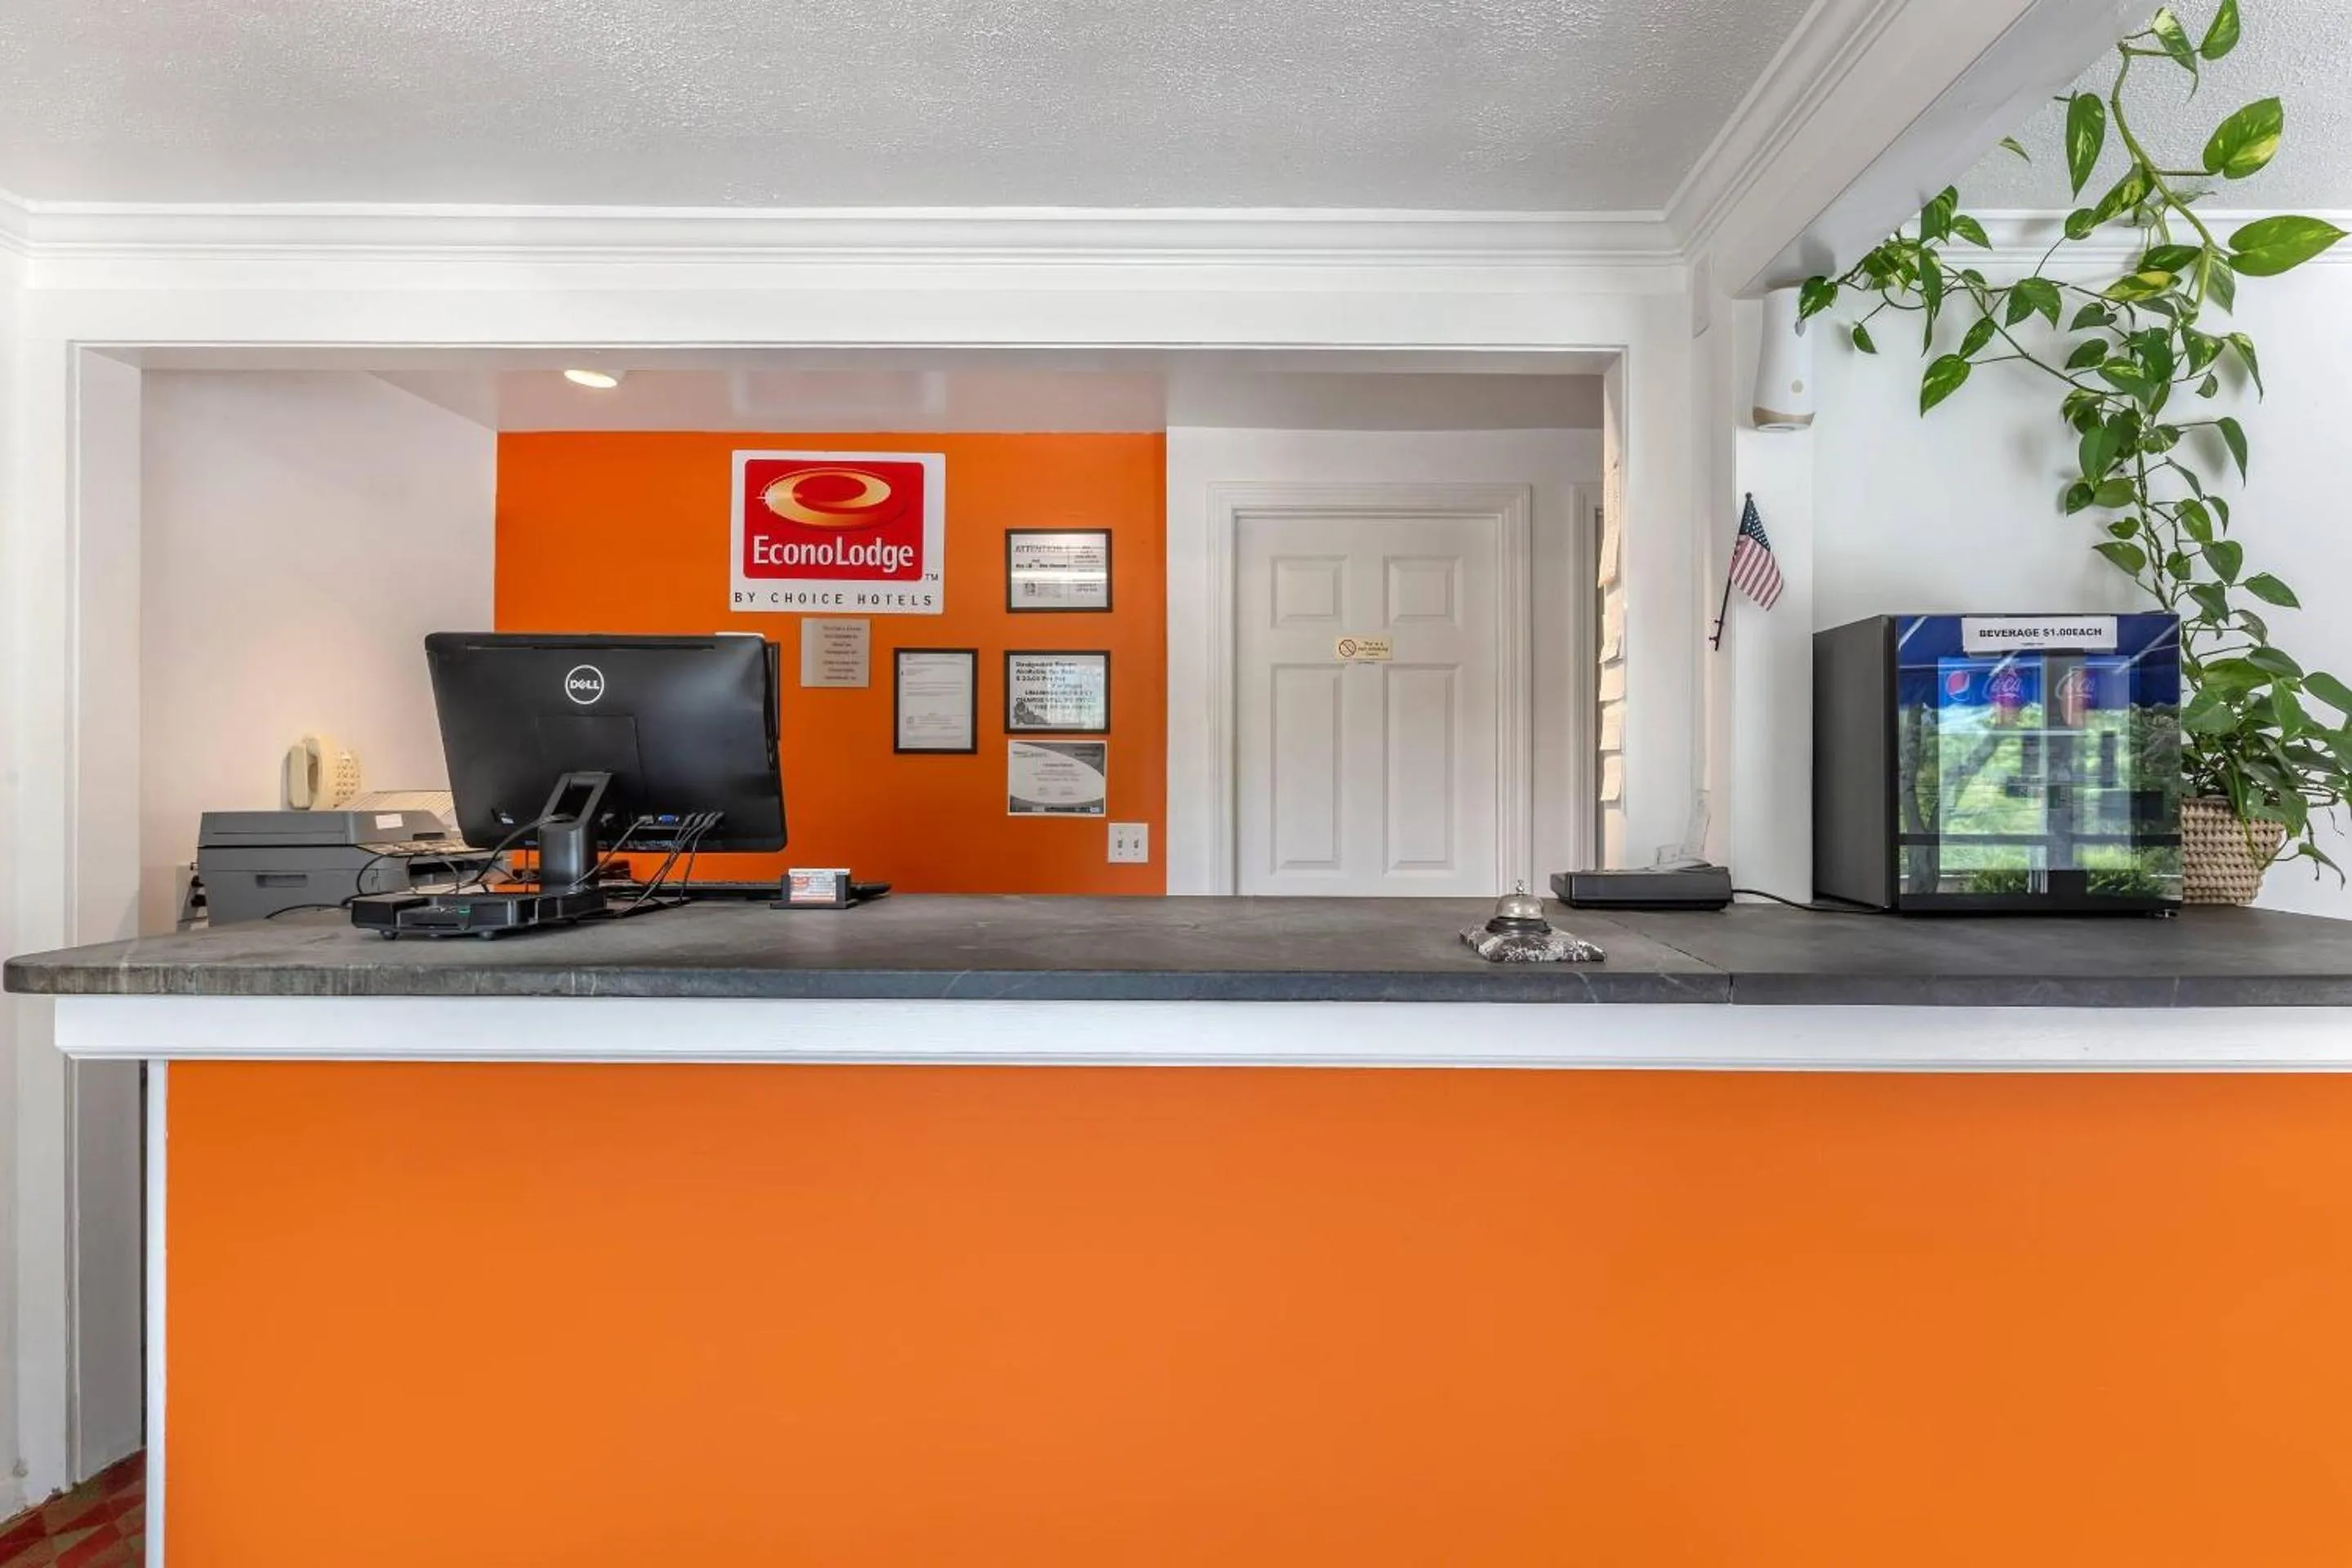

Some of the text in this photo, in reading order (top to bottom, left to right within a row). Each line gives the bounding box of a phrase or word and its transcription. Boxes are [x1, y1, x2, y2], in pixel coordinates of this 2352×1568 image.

[752, 535, 914, 573] EconoLodge
[734, 592, 932, 606] BY CHOICE HOTELS
[1979, 627, 2039, 638] BEVERAGE
[570, 679, 600, 690] DELL
